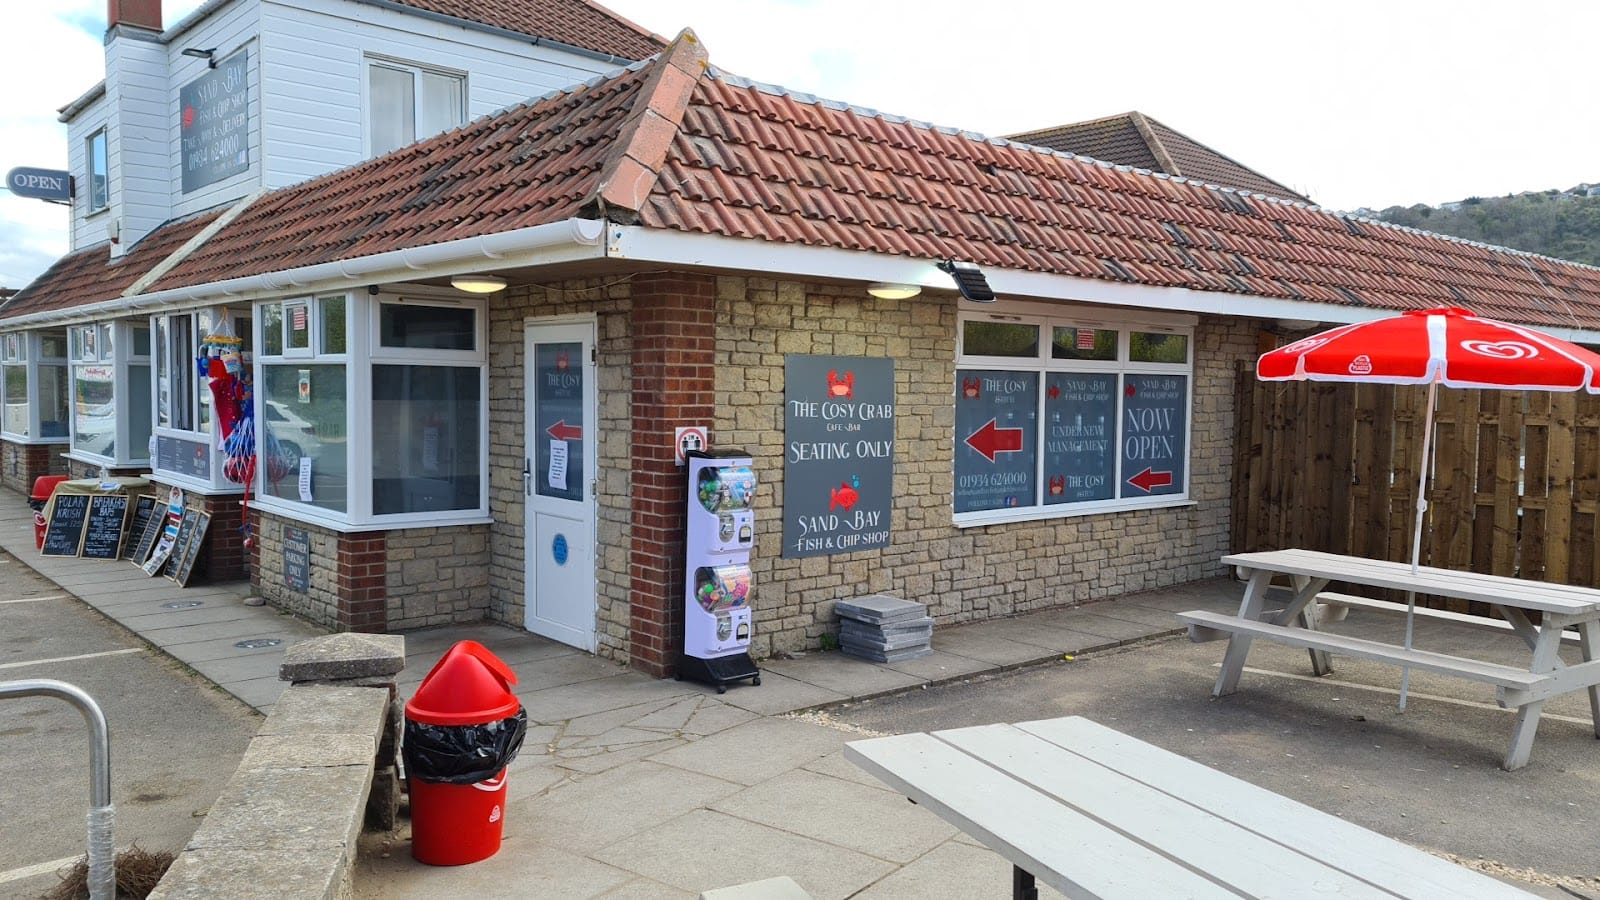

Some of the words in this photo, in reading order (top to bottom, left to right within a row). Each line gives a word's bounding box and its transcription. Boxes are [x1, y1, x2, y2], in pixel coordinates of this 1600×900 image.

[222, 64, 243, 93] BAY
[188, 146, 208, 171] 01934
[210, 134, 240, 161] 624000
[14, 174, 63, 191] OPEN
[545, 373, 560, 386] THE
[561, 373, 581, 389] COSY
[983, 378, 1003, 393] THE
[1004, 380, 1028, 394] COSY
[1066, 380, 1087, 393] SAND
[1088, 380, 1107, 392] BAY
[1142, 380, 1159, 391] SAND
[1160, 379, 1177, 391] BAY
[789, 397, 819, 418] THE
[821, 402, 856, 420] COSY
[858, 402, 893, 421] CRAB
[826, 423, 843, 432] CAFE
[844, 423, 861, 432] BAR
[1127, 407, 1177, 433] NOW
[1052, 425, 1082, 438] UNDER
[1083, 424, 1105, 437] NEW
[789, 441, 850, 464] SEATING
[856, 440, 893, 459] ONLY
[1048, 440, 1109, 453] MANAGEMENT
[1125, 435, 1177, 460] OPEN
[959, 473, 989, 489] 01934
[990, 471, 1027, 487] 624000
[1067, 474, 1083, 489] THE
[1084, 474, 1105, 489] COSY
[58, 496, 84, 507] POLAR
[798, 514, 839, 537] SAND
[840, 510, 881, 531] BAY
[792, 538, 823, 552] FISH
[825, 537, 834, 549] &
[836, 534, 860, 549] CHIP
[862, 531, 889, 545] SHOP
[288, 564, 302, 577] ONLY
